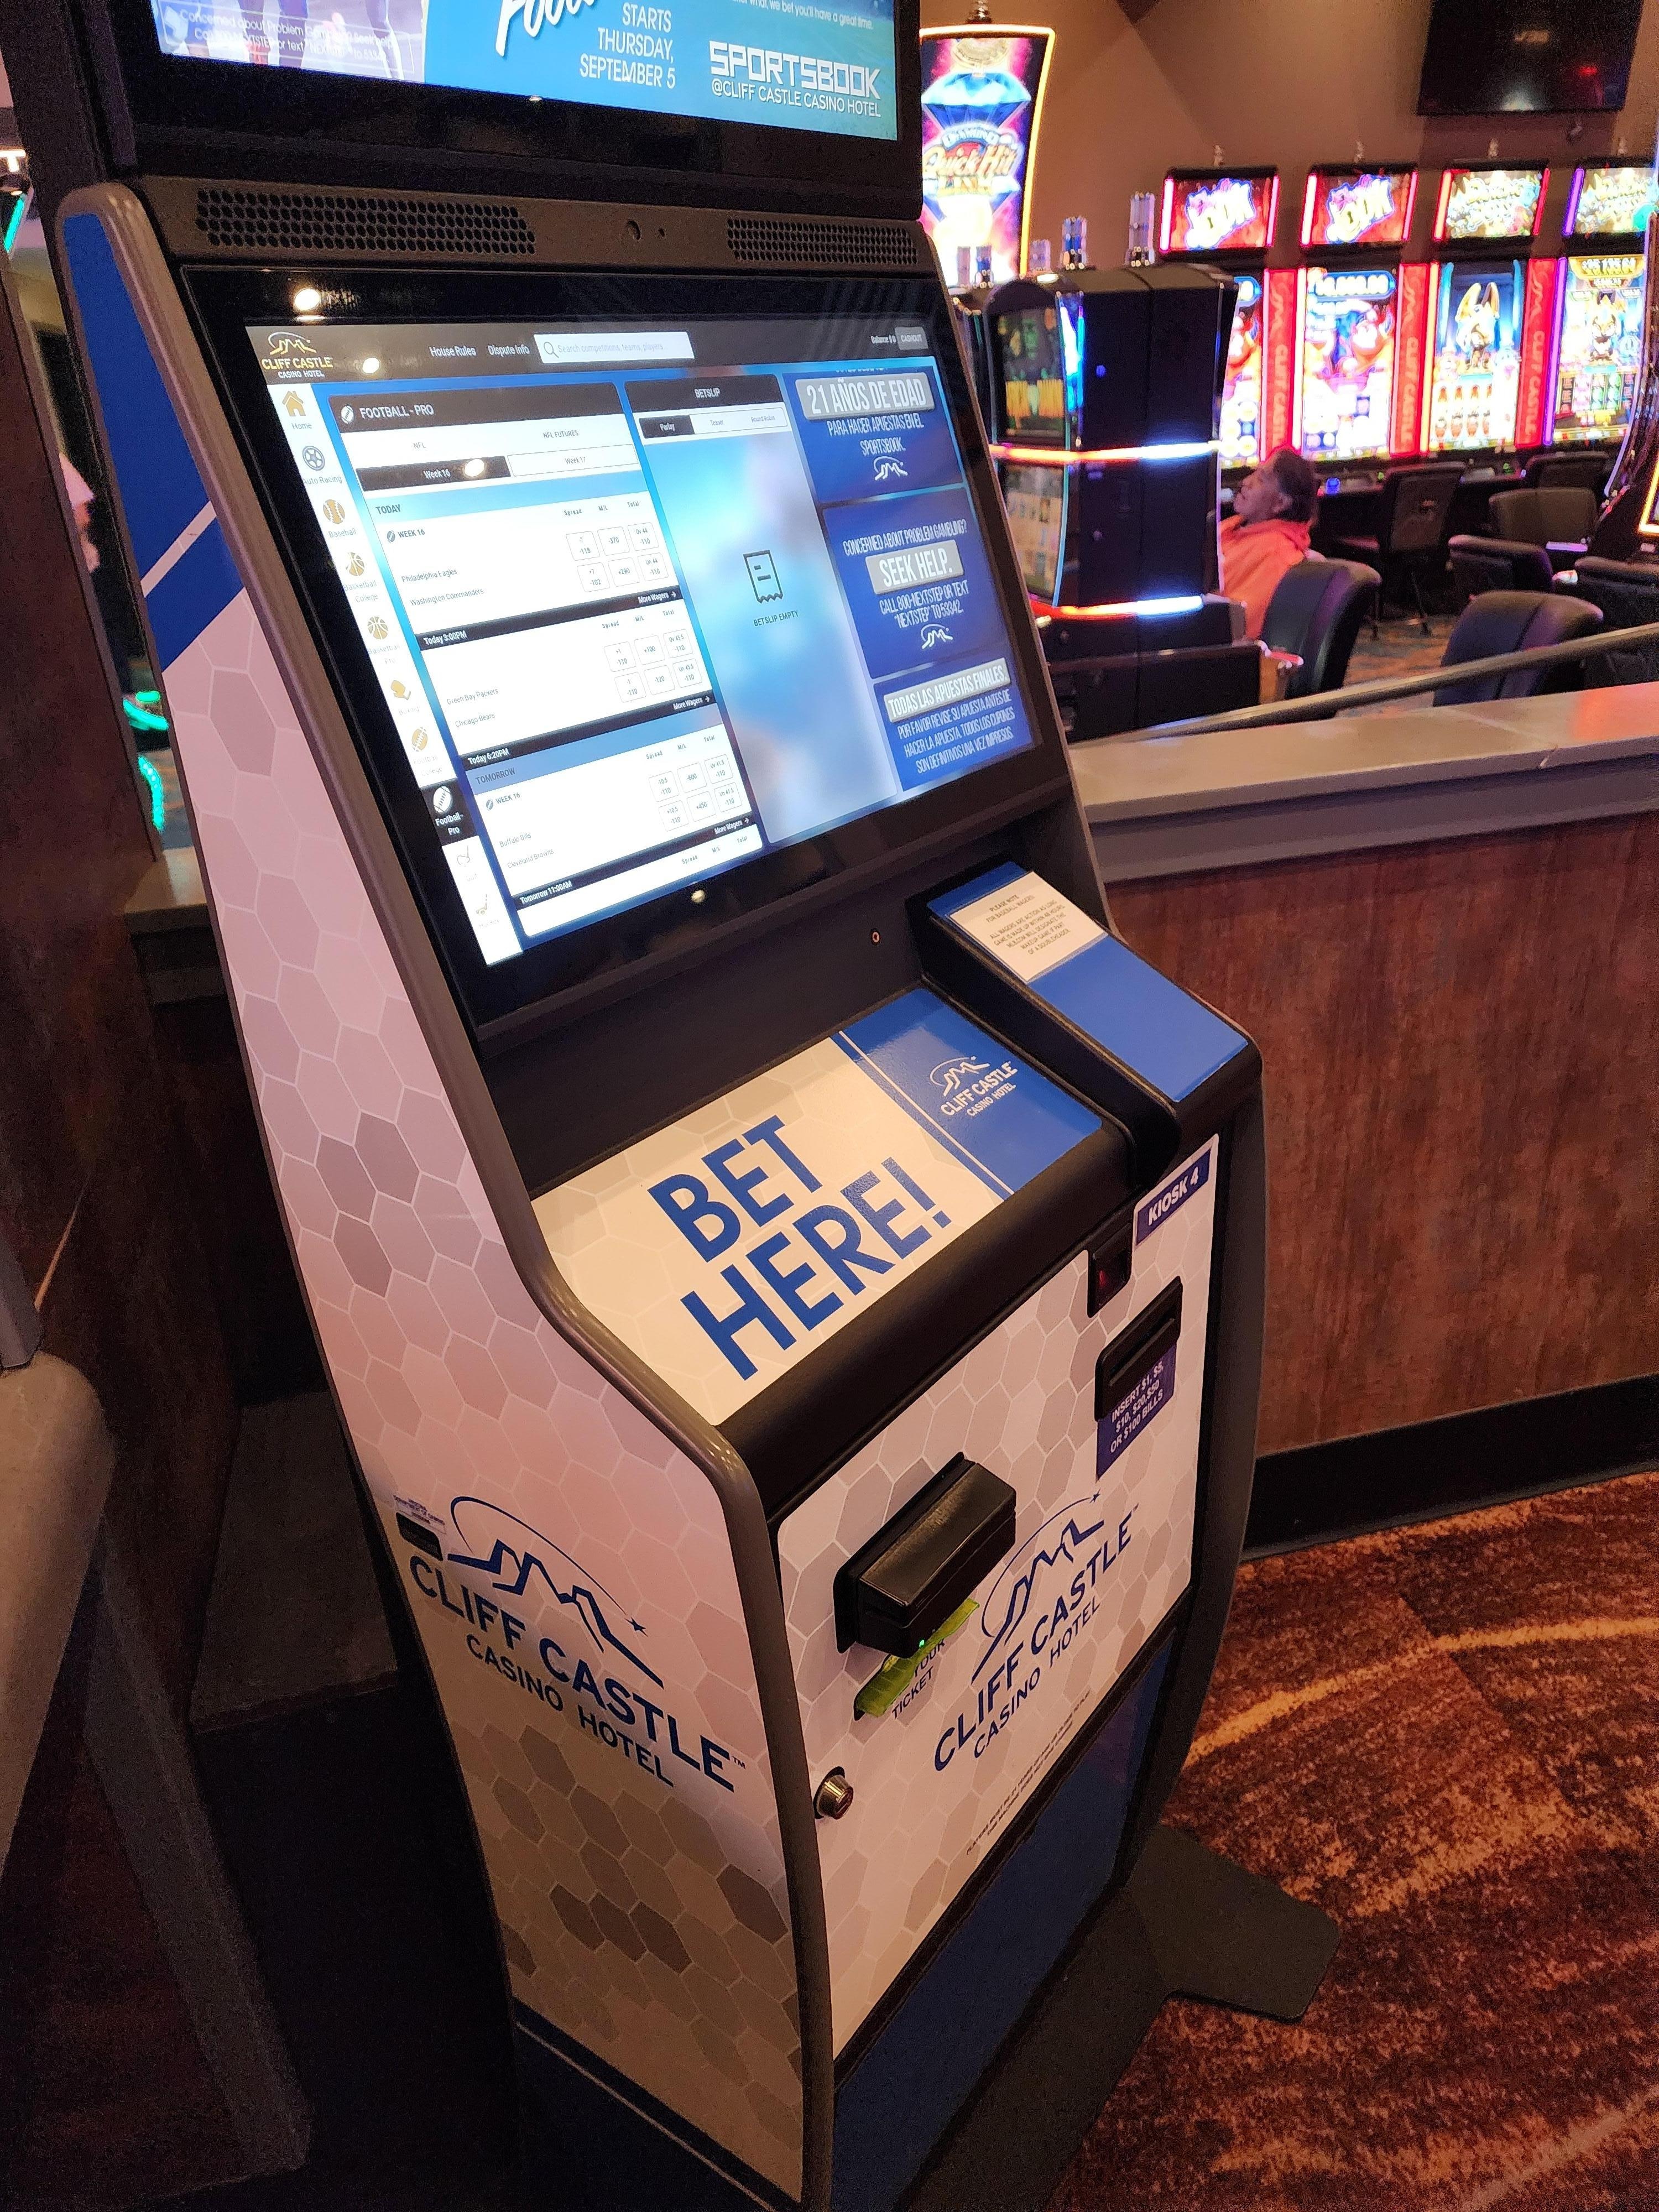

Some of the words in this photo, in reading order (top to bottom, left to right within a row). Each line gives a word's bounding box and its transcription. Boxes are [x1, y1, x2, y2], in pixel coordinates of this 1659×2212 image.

[622, 2, 672, 33] STARTS
[815, 9, 831, 20] have
[832, 14, 838, 23] a
[839, 15, 858, 27] great
[597, 27, 674, 64] THURSDAY,
[579, 53, 663, 87] SEPTEMBER
[666, 67, 676, 89] 5
[709, 40, 881, 100] SPORTSBOOK
[712, 77, 756, 101] @CLIFF
[758, 85, 802, 107] CASTLE
[804, 92, 845, 113] CASINO
[847, 99, 881, 118] HOTEL
[429, 346, 456, 358] House
[455, 343, 477, 357] Rules
[487, 344, 515, 357] Dispute
[557, 343, 581, 354] Search
[261, 357, 291, 371] CLIFF
[304, 370, 325, 378] HOTEL
[695, 388, 721, 399] BETSLIP
[806, 384, 830, 415] 21
[830, 376, 870, 413] AÑOS
[867, 380, 891, 409] DE
[888, 378, 927, 408] EDAD
[359, 405, 409, 419] FOOTBALL
[413, 404, 434, 416] PRO
[555, 429, 579, 439] FUTURES
[826, 419, 849, 437] PARA
[848, 416, 873, 435] HACER
[872, 414, 906, 433] APUESTAS
[904, 413, 916, 430] EN
[914, 412, 925, 429] EL
[319, 476, 343, 484] Racing
[423, 469, 442, 480] Week
[441, 468, 451, 478] 16
[565, 456, 579, 465] Week
[579, 455, 587, 464] 17
[375, 503, 401, 515] TODAY
[563, 508, 583, 517] Spread
[328, 527, 357, 539] Baseball
[397, 529, 416, 539] WEEK
[416, 528, 426, 536] 16
[842, 535, 885, 557] CONCERNED
[884, 531, 906, 549] ABOUT
[903, 526, 935, 546] PROBLEM
[932, 519, 968, 538] GAMBLING?
[401, 570, 439, 583] Philadelphia
[437, 568, 457, 577] Eagles
[879, 555, 917, 588] SEEK
[914, 547, 953, 580] HELP.
[410, 593, 446, 606] Washington
[445, 587, 484, 601] Commanders
[638, 594, 651, 604] More
[650, 592, 669, 602] Wagers
[879, 598, 898, 615] CALL
[896, 587, 944, 612] 800-NEXTSTEP
[942, 585, 953, 598] OR
[951, 580, 969, 596] TEXT
[753, 614, 779, 627] BETSLIP
[778, 609, 800, 621] EMPTY
[929, 604, 942, 619] TO
[423, 635, 444, 646] Today
[442, 629, 468, 642] 3:00PM
[446, 695, 464, 706] Green
[463, 693, 477, 702] Bay
[476, 687, 499, 698] Packers
[888, 693, 920, 718] TODAS
[916, 688, 935, 708] LAS
[933, 675, 975, 702] APUESTAS
[972, 665, 1008, 690] FINALES.
[897, 723, 914, 740] POR
[911, 717, 934, 735] FAVOR
[931, 709, 953, 729] REVISE
[951, 707, 962, 721] SU
[960, 697, 987, 718] APUESTA
[984, 691, 1004, 710] ANTES
[1000, 688, 1013, 703] DE
[903, 740, 927, 758] HACER
[923, 735, 936, 751] LA
[960, 717, 983, 737] TODOS
[467, 754, 487, 765] Today
[486, 747, 510, 761] 6:20PM
[475, 766, 516, 785] TOMORROW
[447, 826, 461, 836] Pro
[519, 889, 549, 905] Tomorrow
[547, 879, 573, 895] 11:00AM
[941, 1088, 975, 1116] CLIFF
[967, 1095, 994, 1117] CASINO
[991, 1082, 1017, 1100] HOTEL
[647, 1114, 823, 1264] BET
[1147, 1175, 1188, 1227] KIOSK
[1190, 1166, 1199, 1186] 4
[680, 1156, 952, 1381] HERE!
[1111, 1384, 1141, 1423] INSERT
[1110, 1433, 1123, 1454] OR
[1123, 1413, 1141, 1439] $100
[1141, 1388, 1164, 1420] BILLS
[409, 1554, 526, 1650] CLIFF
[973, 1667, 1040, 1759] CASINO
[1050, 1595, 1100, 1668] HOTEL
[891, 1665, 934, 1720] TICKET
[466, 1633, 564, 1712] CASINO
[577, 1704, 675, 1788] HOTEL
[934, 1640, 1025, 1772] CLIFF
